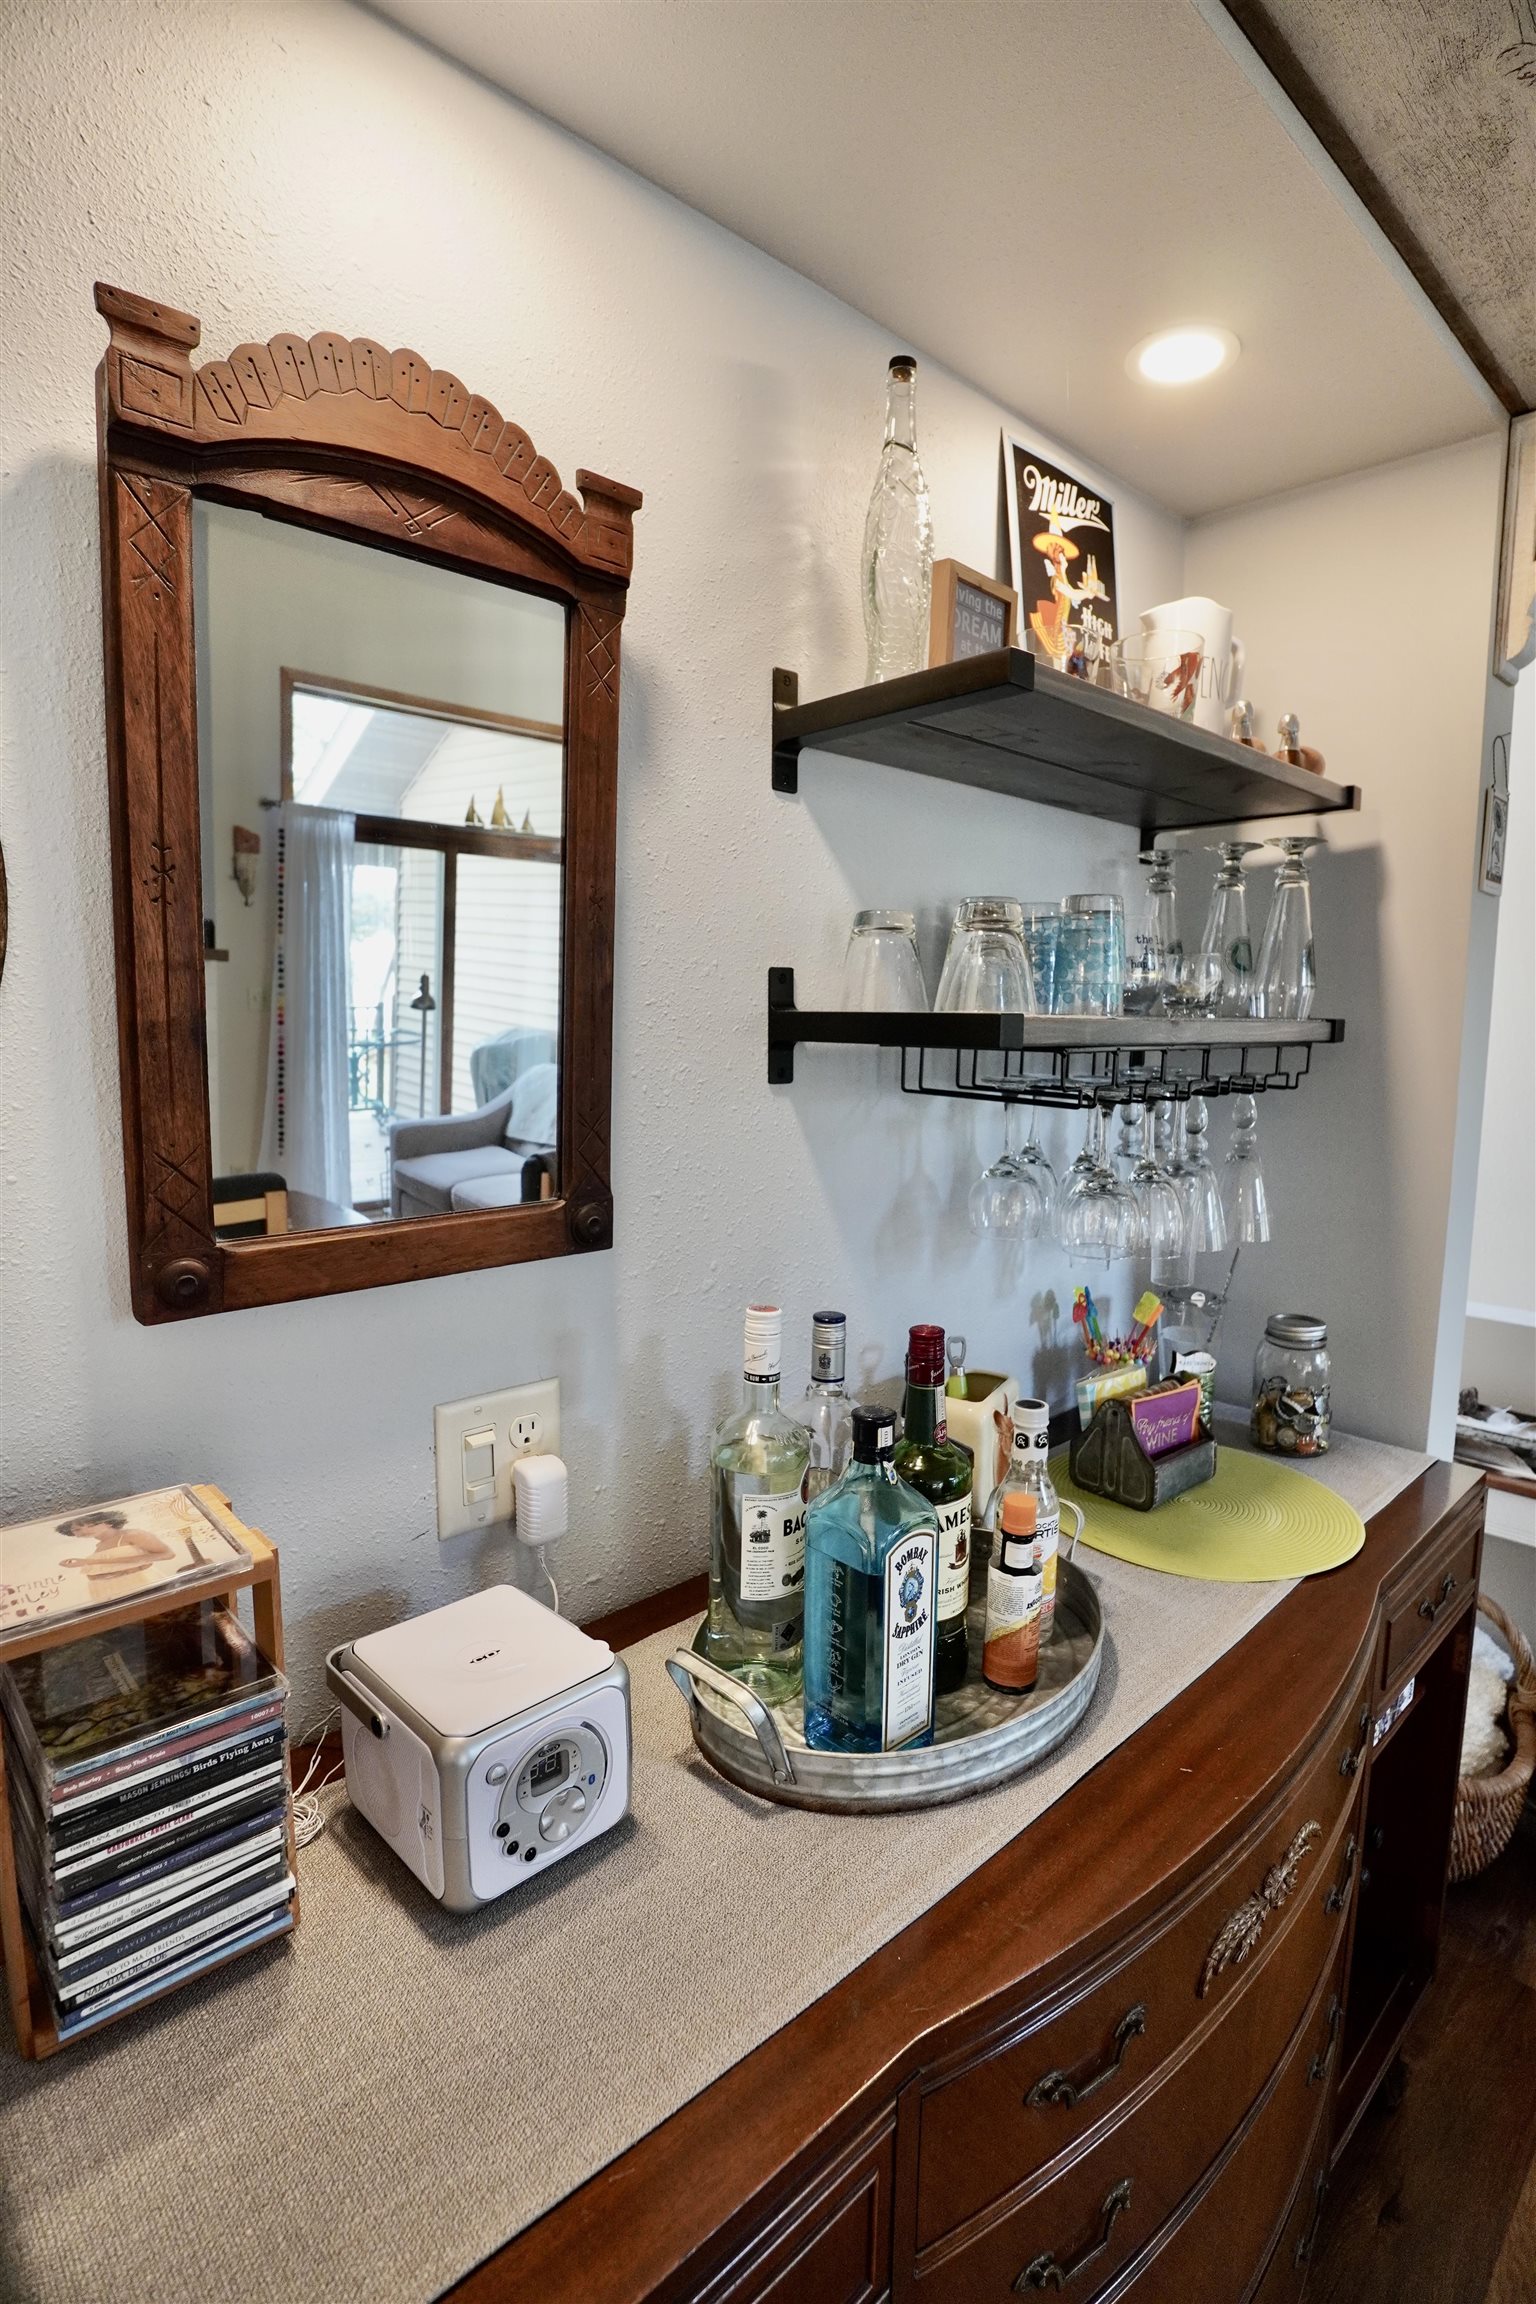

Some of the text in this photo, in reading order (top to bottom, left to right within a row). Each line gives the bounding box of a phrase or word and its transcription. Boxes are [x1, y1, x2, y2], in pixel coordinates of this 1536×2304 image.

[1023, 465, 1100, 520] Miller
[985, 599, 1002, 619] the
[1081, 604, 1113, 640] HIGH
[960, 639, 971, 655] at
[1134, 934, 1153, 944] the
[1145, 1427, 1178, 1450] WINE
[895, 1546, 928, 1576] BOMBAY
[892, 1608, 928, 1639] SAPPHIRE
[896, 1649, 924, 1669] DRY GIN
[900, 1645, 921, 1660] LONDON
[897, 1668, 923, 1687] INFUSED
[78, 1774, 101, 1787] Marley
[133, 1756, 146, 1766] That
[149, 1749, 165, 1760] Train
[119, 1786, 148, 1802] MASON
[193, 1756, 217, 1773] Birds
[219, 1745, 249, 1762] Flying
[251, 1735, 273, 1748] Away
[117, 1853, 141, 1869] clapton
[143, 1839, 175, 1857] chronicles
[107, 1892, 131, 1910] road
[74, 1897, 160, 1942] Supernatural Santana
[150, 1921, 173, 1937] LANZ
[106, 1959, 129, 1977] YO-YO
[132, 1953, 142, 1963] MA
[153, 1934, 185, 1954] FRIENDS
[83, 1971, 125, 1999] NARADA
[128, 1950, 167, 1976] DECADE
